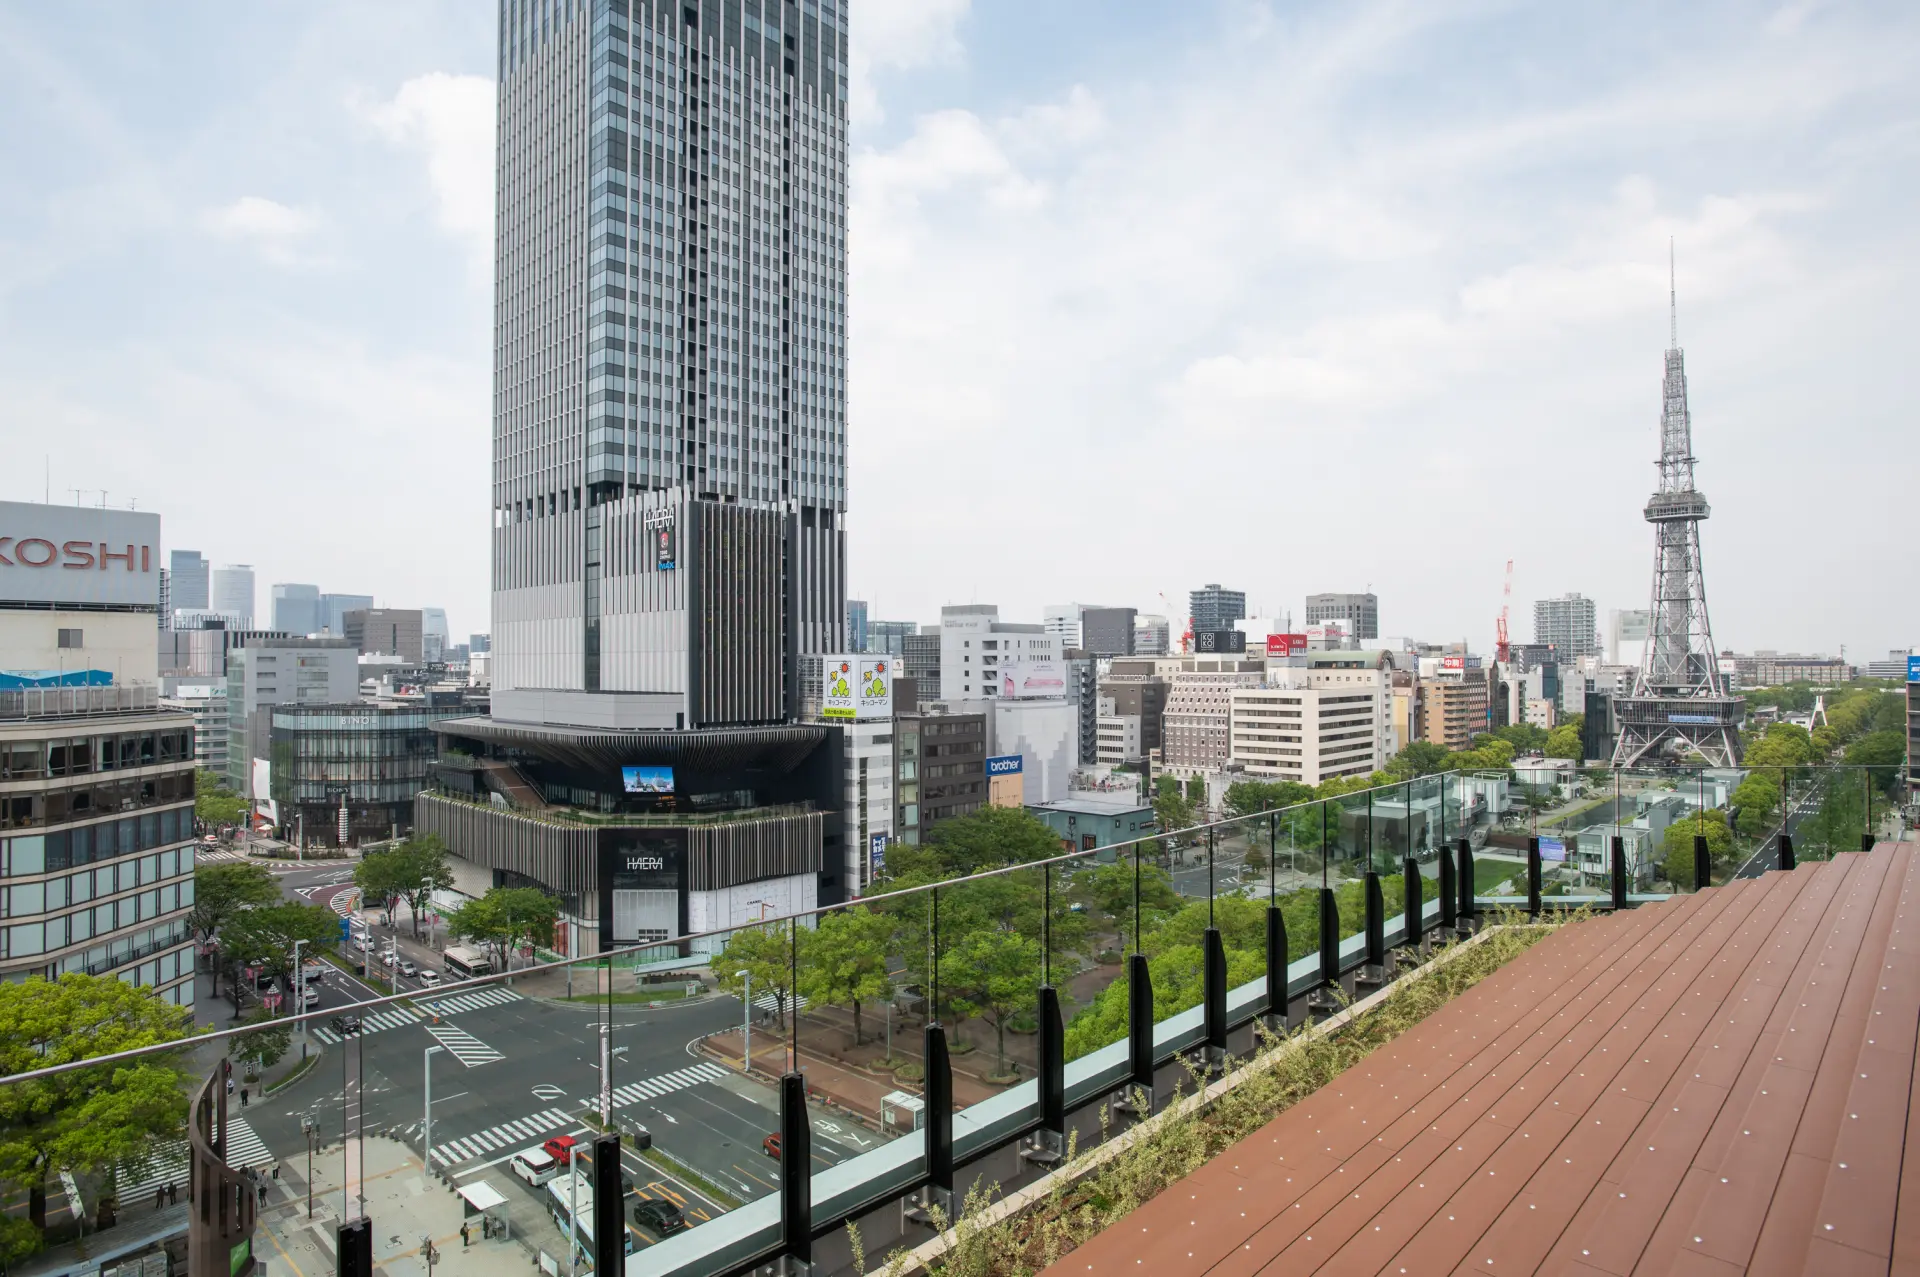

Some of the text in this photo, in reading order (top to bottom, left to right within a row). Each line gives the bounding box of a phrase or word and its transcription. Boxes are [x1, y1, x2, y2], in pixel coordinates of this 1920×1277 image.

[860, 698, 888, 706] キッコーマン
[341, 716, 370, 725] BINO
[990, 759, 1020, 773] brother
[626, 856, 663, 870] HAERA
